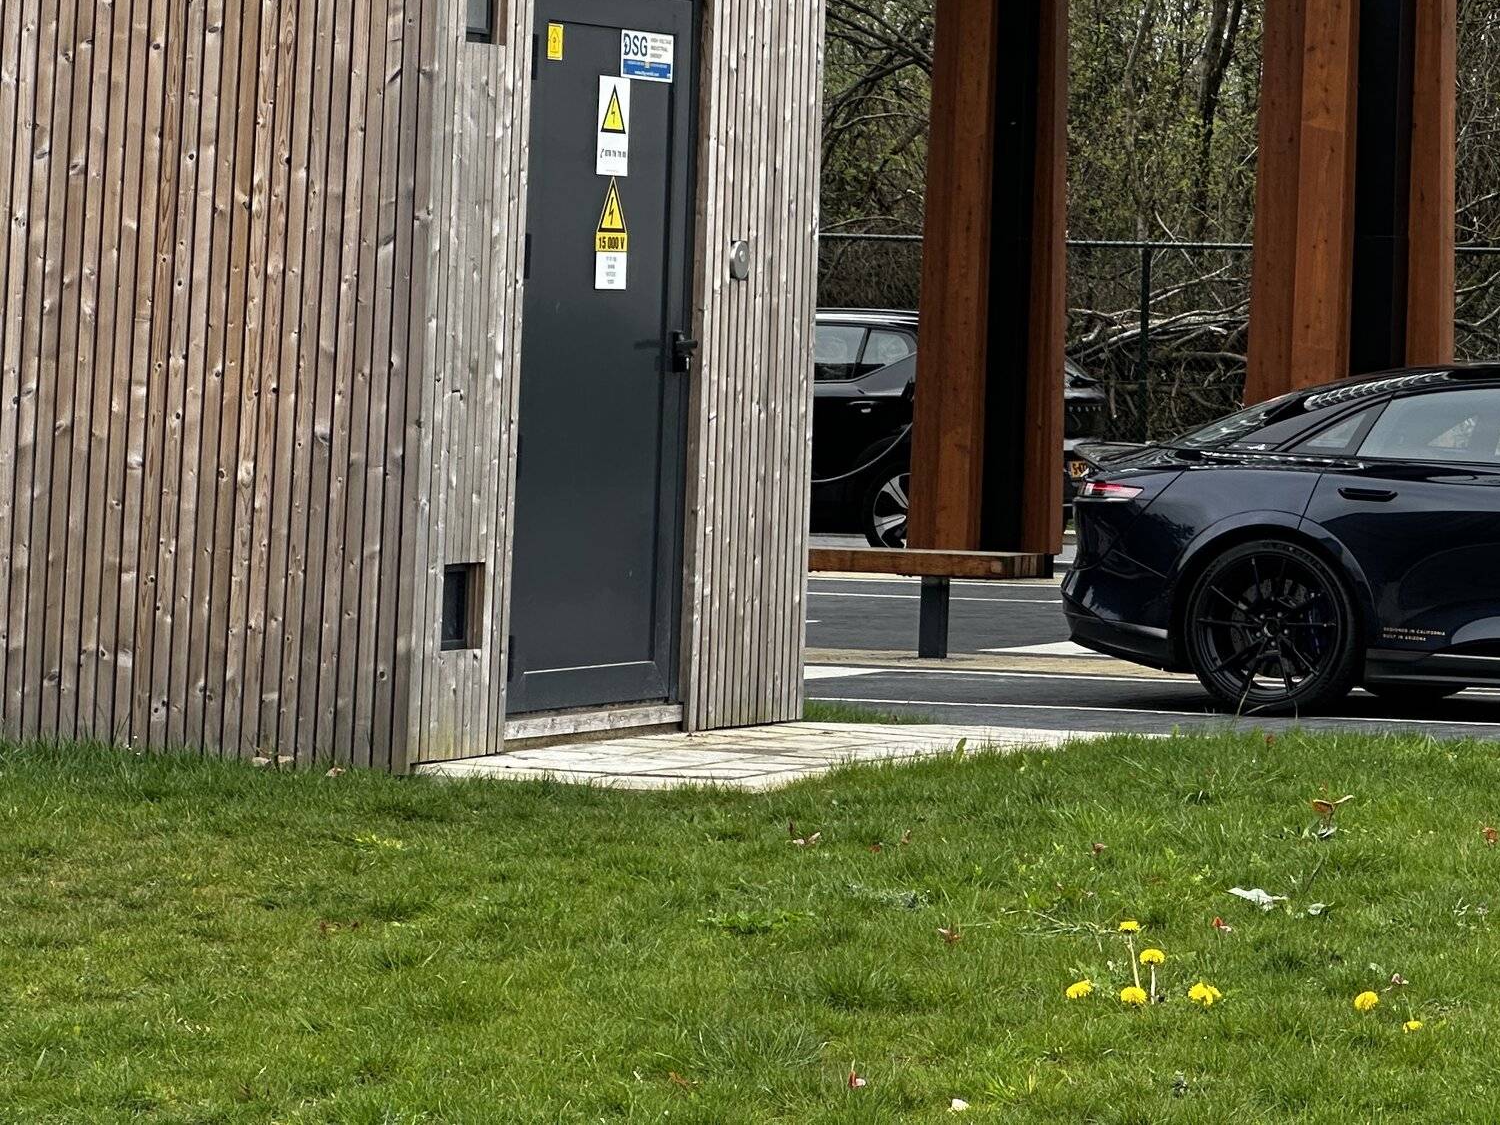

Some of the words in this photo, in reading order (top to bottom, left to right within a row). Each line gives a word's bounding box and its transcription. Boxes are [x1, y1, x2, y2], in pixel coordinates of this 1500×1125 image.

[623, 33, 648, 57] DSG
[598, 236, 607, 250] 15
[607, 236, 619, 250] 000
[620, 237, 625, 250] V
